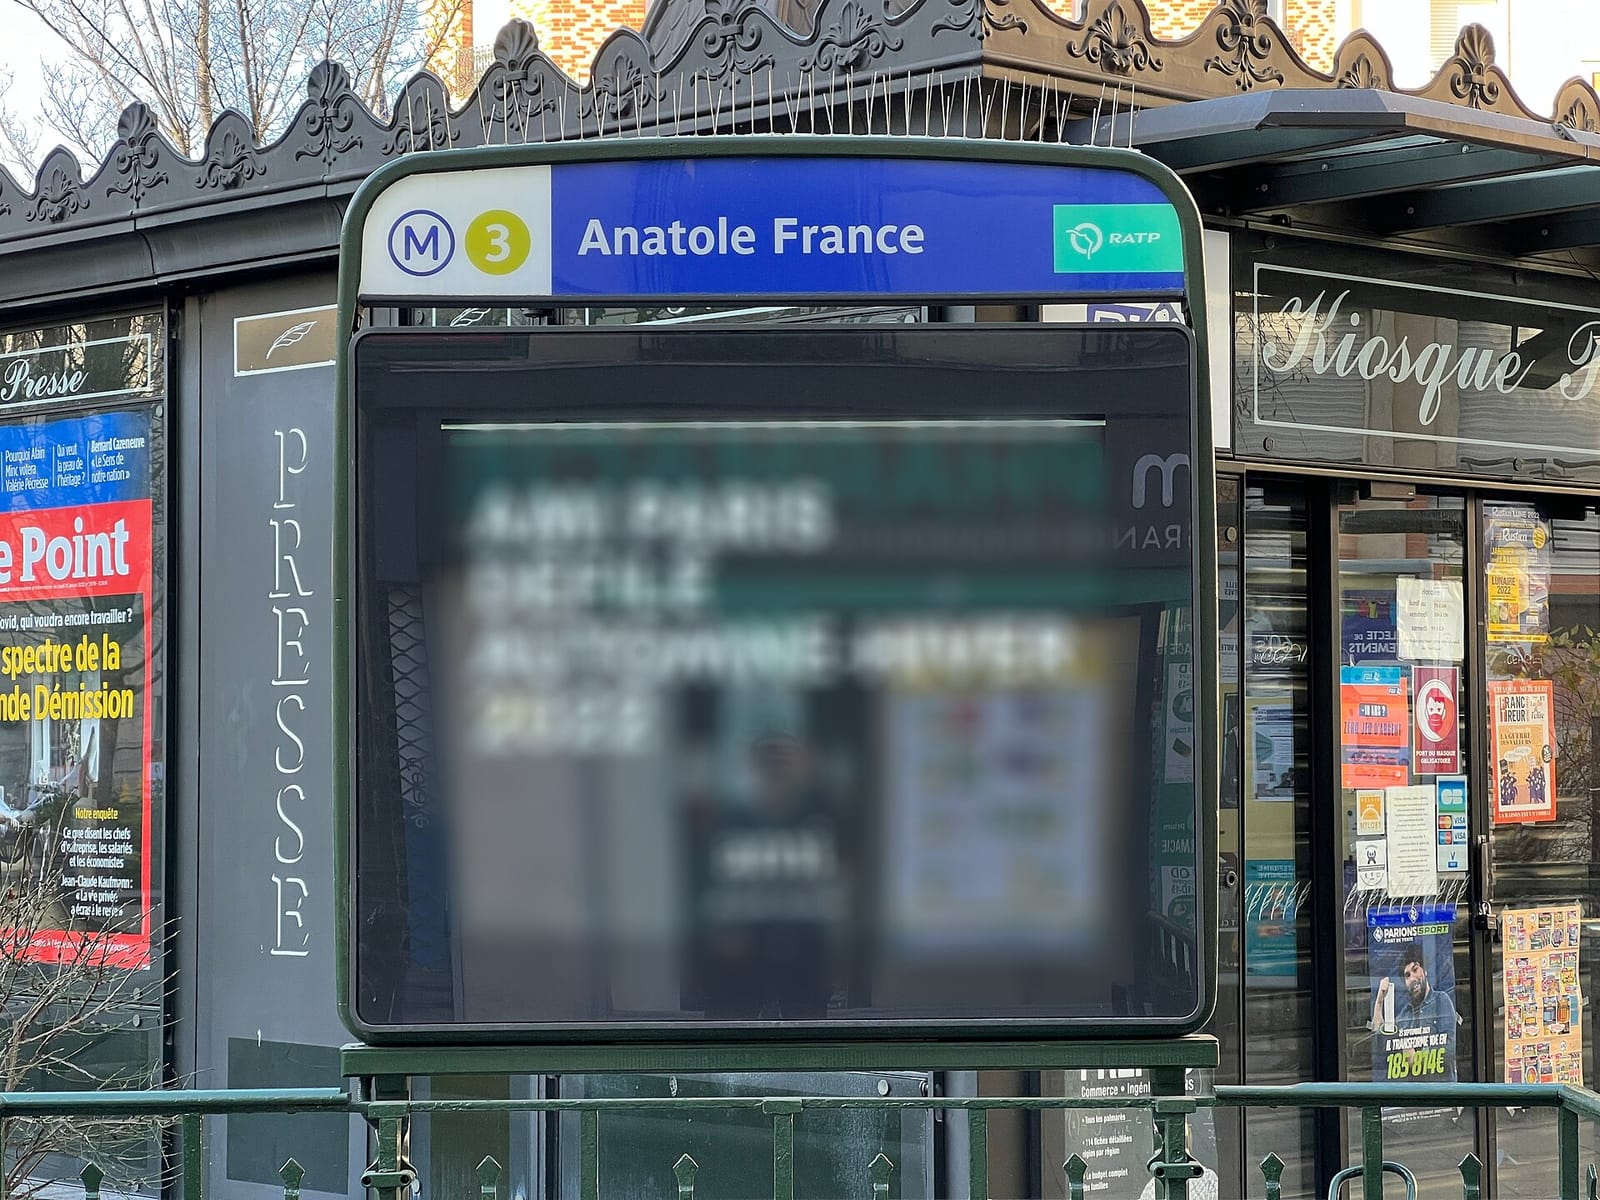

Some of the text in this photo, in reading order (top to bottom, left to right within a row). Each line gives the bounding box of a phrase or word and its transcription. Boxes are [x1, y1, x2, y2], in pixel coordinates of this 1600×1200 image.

[577, 216, 925, 256] Anatole France
[1109, 232, 1161, 244] RATP
[1262, 288, 1536, 426] Kiosque
[0, 358, 89, 401] Presse
[91, 437, 145, 452] Bernard Cazeneuve
[5, 447, 45, 463] Pourquoi Alain
[25, 477, 48, 490] Pécresse
[20, 516, 129, 581] Point
[1497, 586, 1511, 594] 2022
[0, 615, 19, 631] ovid,
[20, 613, 33, 630] qui
[34, 612, 63, 627] voudra
[65, 614, 90, 626] encore
[90, 608, 126, 624] travailler
[2, 632, 120, 681] spectre de la
[268, 428, 313, 957] PRESSE
[34, 681, 134, 721] Démission
[1441, 789, 1463, 804] CB
[76, 807, 118, 821] Notre enquête
[1454, 816, 1465, 824] VISA
[63, 827, 71, 838] Ce
[84, 827, 102, 839] disent
[103, 827, 112, 839] les
[113, 827, 131, 839] chefs
[99, 841, 107, 853] les
[77, 855, 86, 867] les
[1384, 925, 1448, 938] PARIONS SPORT
[1081, 1081, 1151, 1097] Commerce Ingéni
